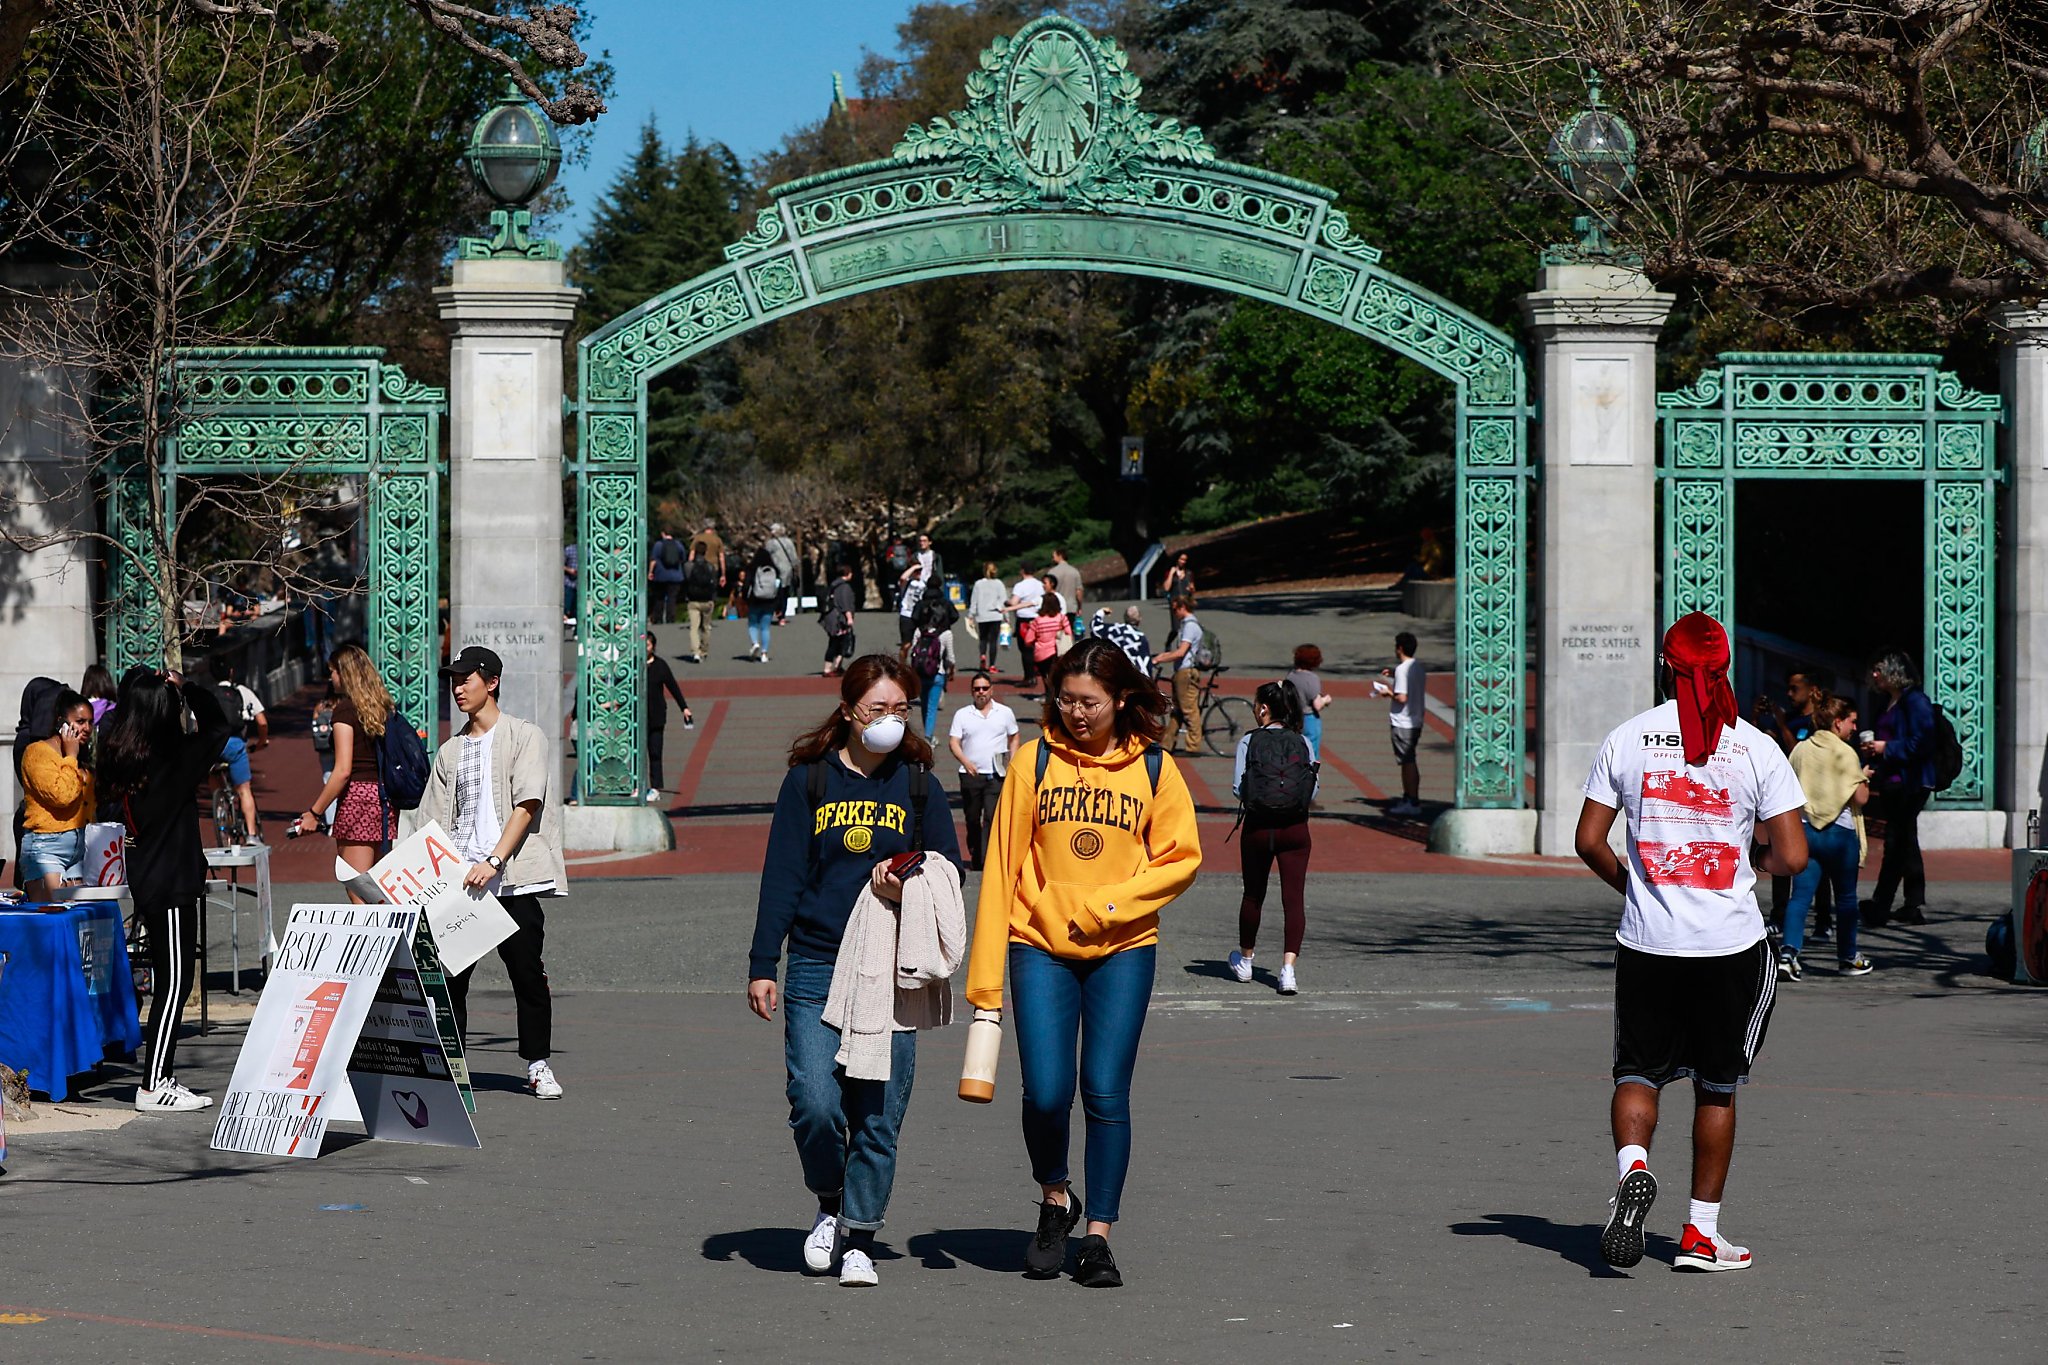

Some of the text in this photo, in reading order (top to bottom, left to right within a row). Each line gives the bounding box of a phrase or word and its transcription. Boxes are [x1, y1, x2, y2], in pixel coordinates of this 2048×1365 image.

[901, 222, 1208, 264] SATHER GATE
[475, 621, 534, 629] ERECTED BY
[462, 634, 490, 644] JANE
[505, 634, 545, 645] SATHER
[1561, 637, 1641, 648] PEDER SATHER
[1732, 748, 1745, 756] DAY
[1733, 742, 1750, 752] RACE
[1038, 786, 1145, 837] BERKELEY
[275, 930, 333, 971] RSVP
[222, 1091, 253, 1116] API
[213, 1115, 286, 1155] CONFERENCE
